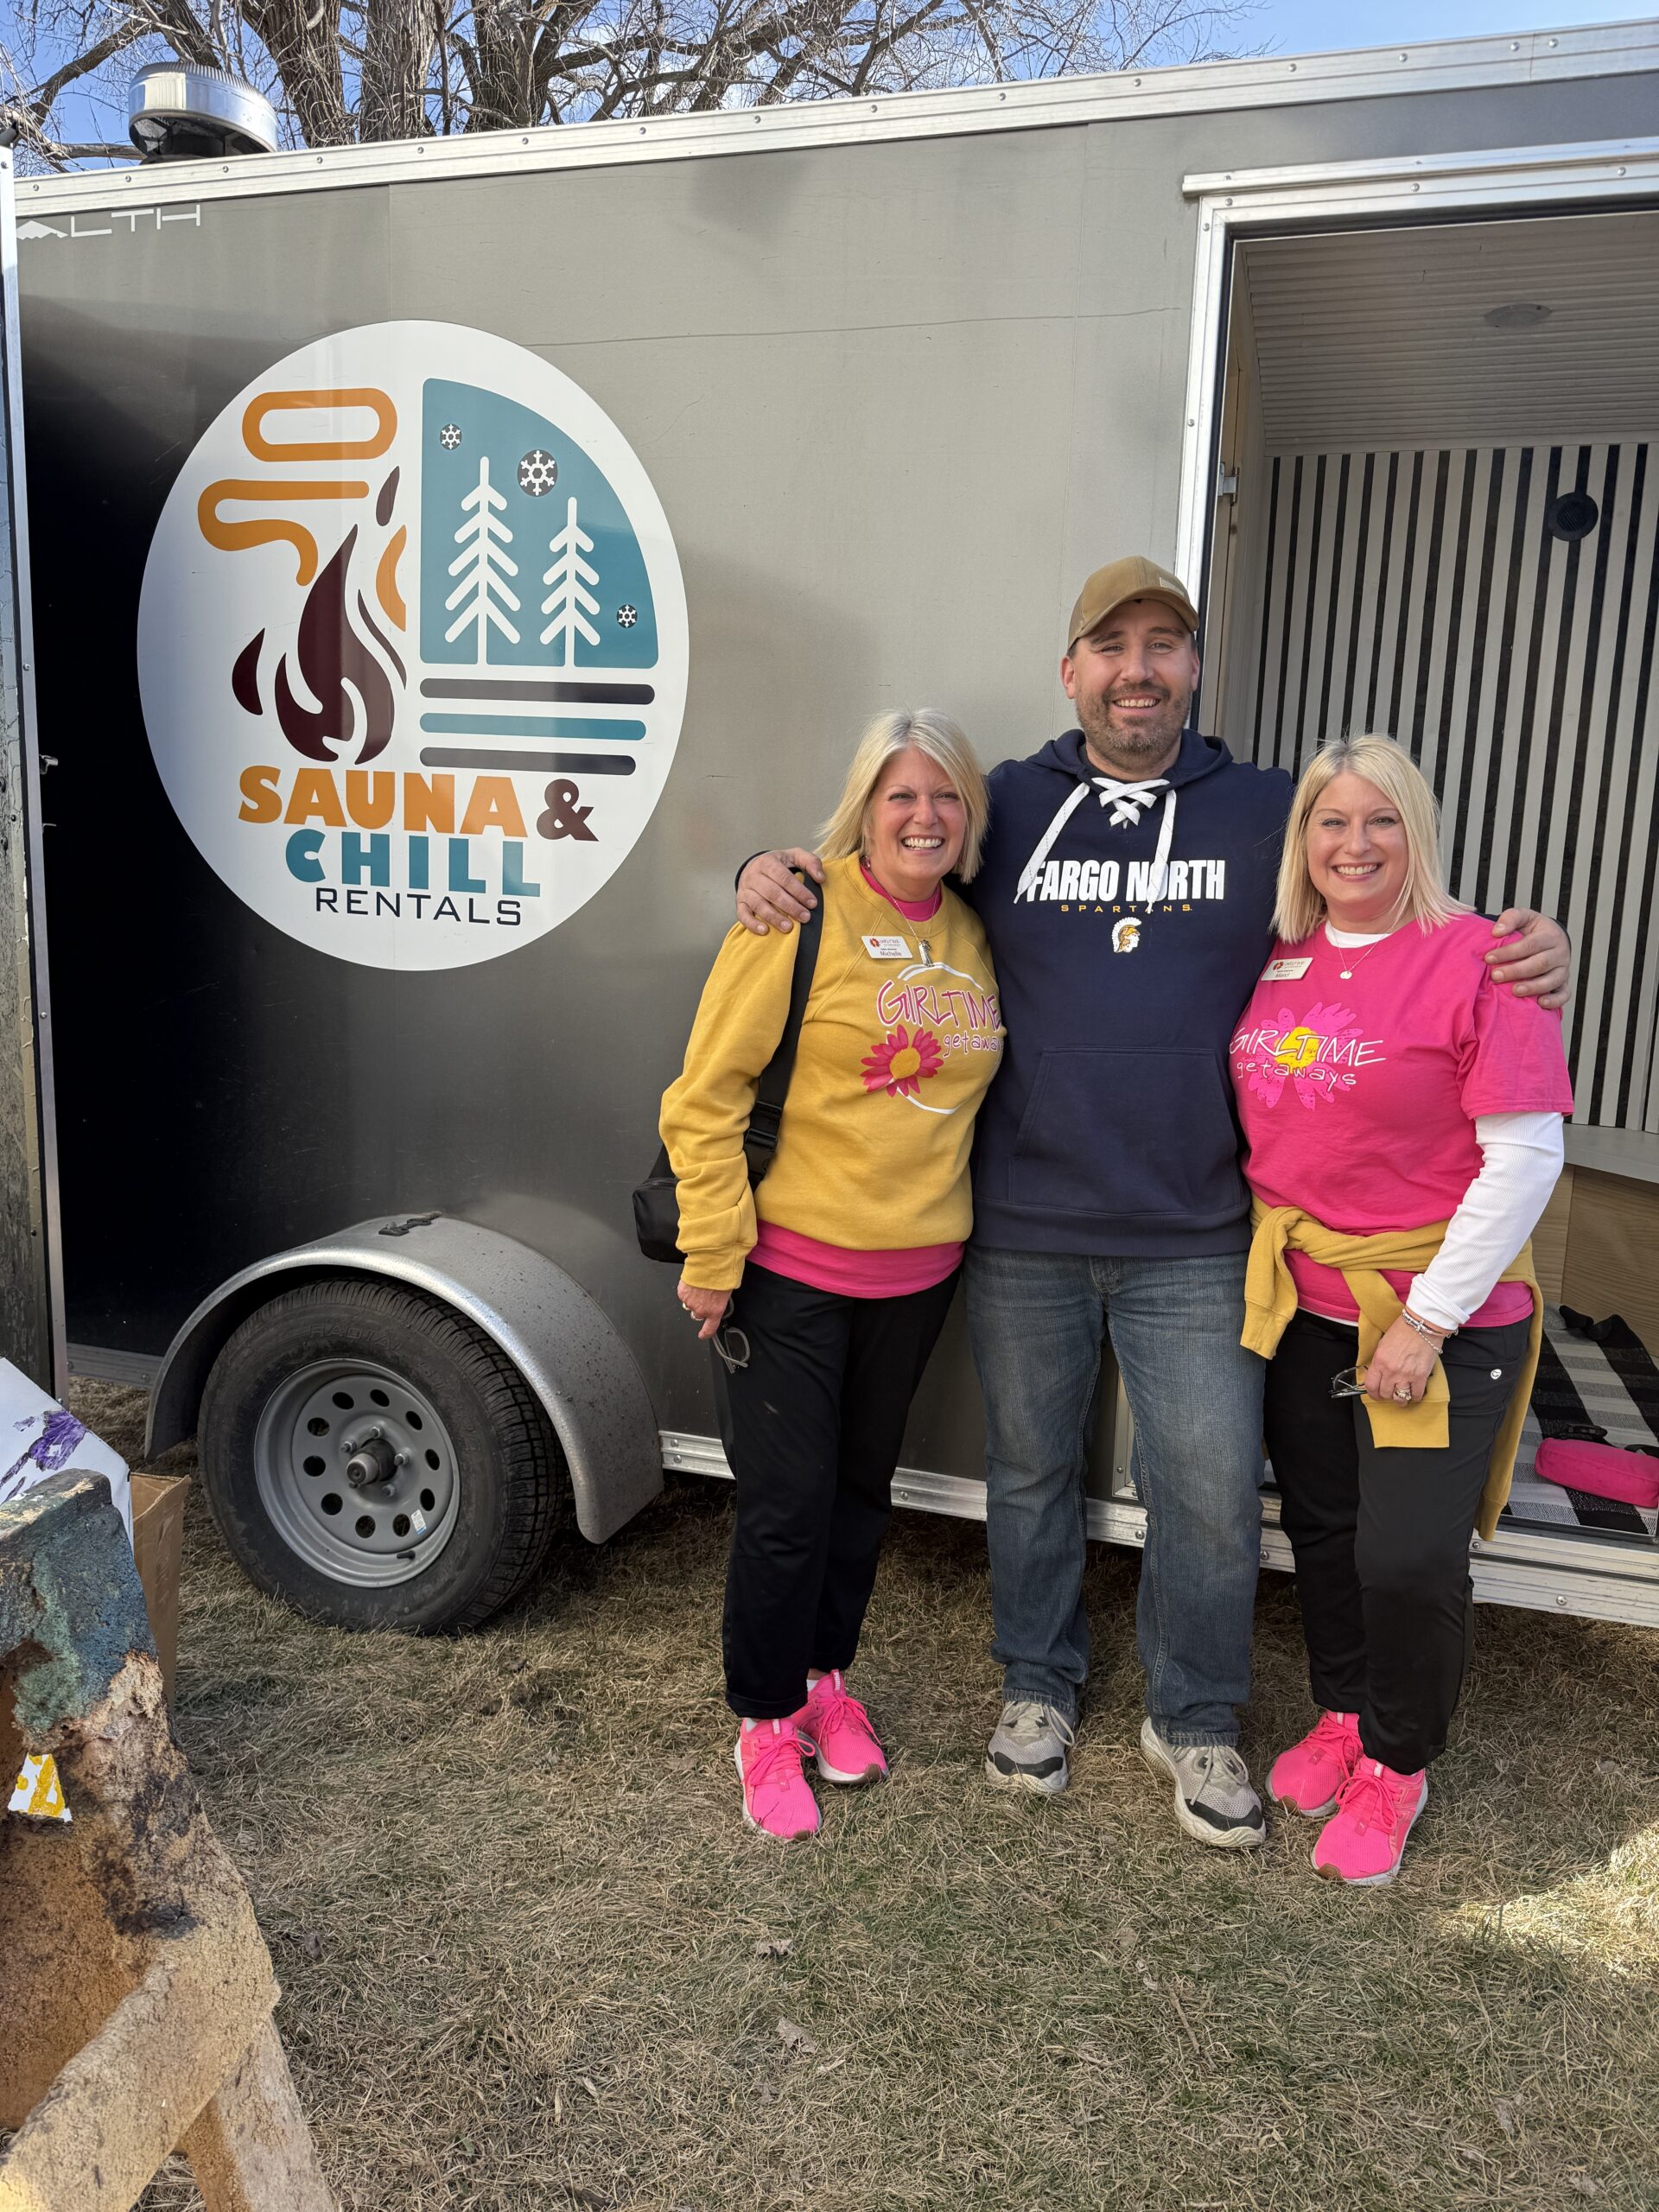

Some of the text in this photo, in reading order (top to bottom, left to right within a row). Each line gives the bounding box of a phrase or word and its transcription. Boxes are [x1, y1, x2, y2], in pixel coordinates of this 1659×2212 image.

[238, 765, 600, 842] SAUNA &
[285, 828, 541, 898] CHILL
[1027, 859, 1120, 902] FARGO
[315, 887, 521, 925] RENTALS
[876, 979, 1002, 1033] GIRLTIME
[943, 1030, 1004, 1058] getawa
[1230, 1027, 1387, 1067] GIRLTIME
[1236, 1058, 1357, 1092] getaways
